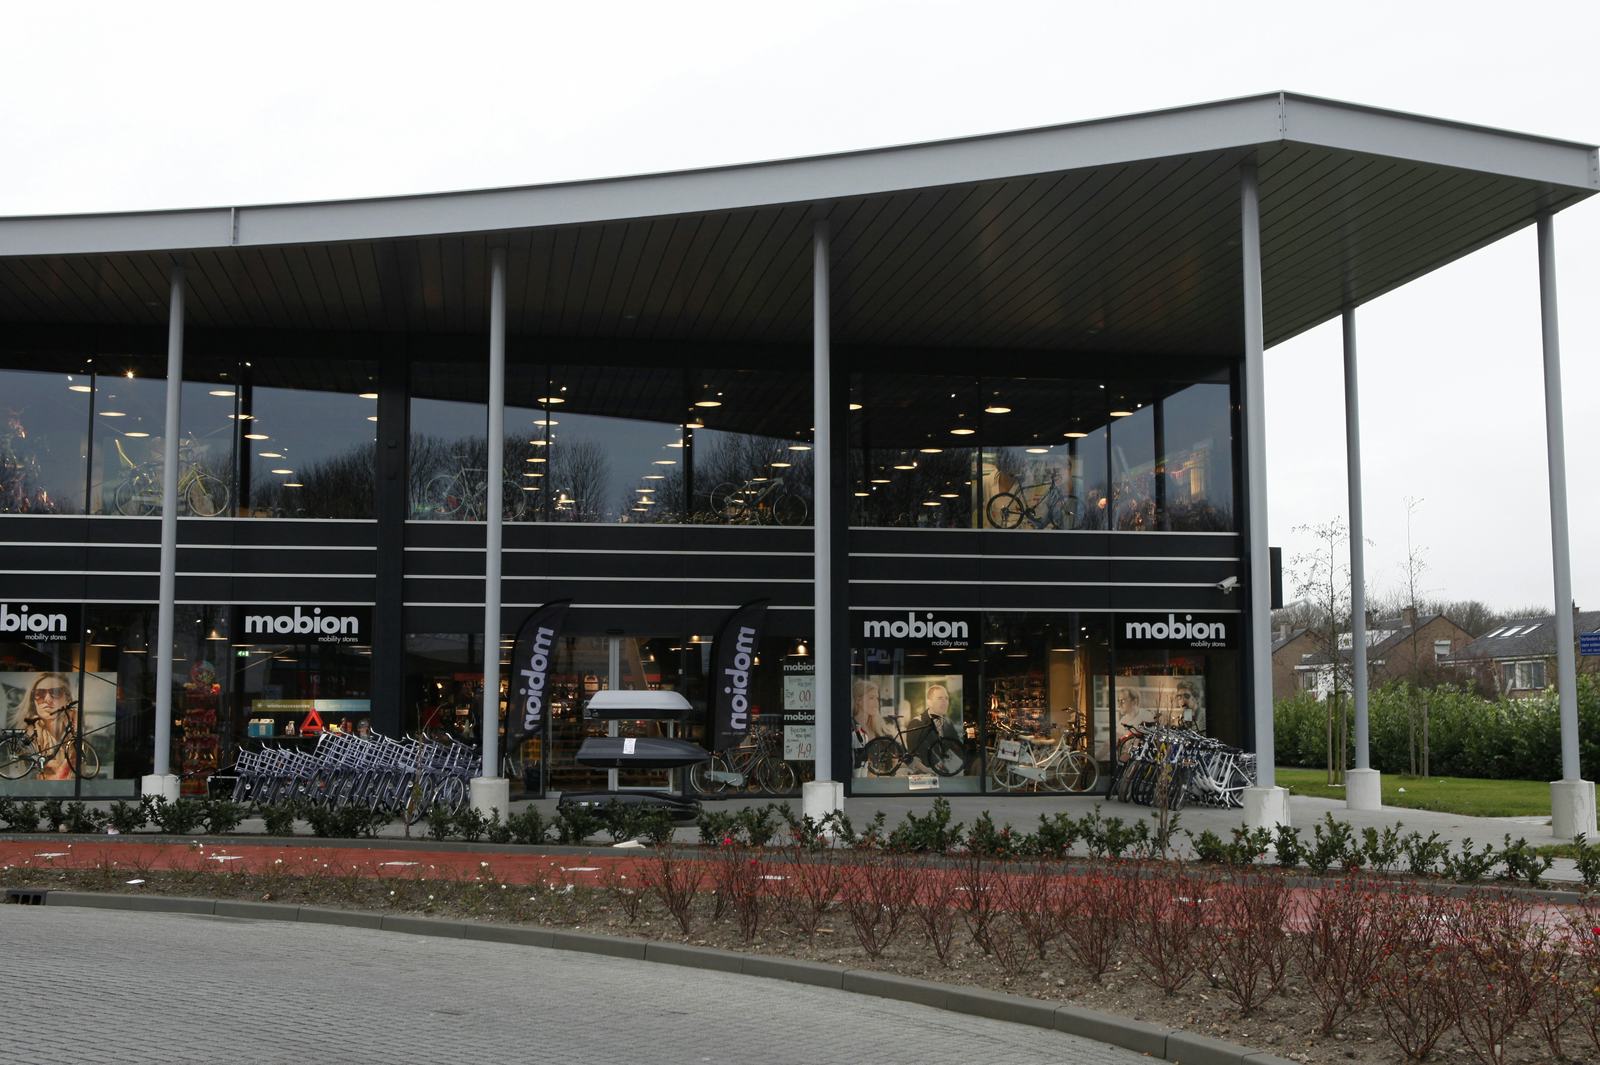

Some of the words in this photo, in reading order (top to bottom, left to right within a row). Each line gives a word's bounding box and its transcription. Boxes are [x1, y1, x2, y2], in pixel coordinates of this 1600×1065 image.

[0, 604, 67, 632] bion
[245, 606, 359, 634] mobion
[863, 612, 969, 638] mobion
[1125, 613, 1226, 639] mobion
[25, 633, 49, 642] mobility
[318, 635, 341, 644] mobility
[931, 639, 953, 647] mobility
[1190, 640, 1211, 649] mobility
[520, 626, 554, 731] mobion
[724, 626, 756, 730] mobion
